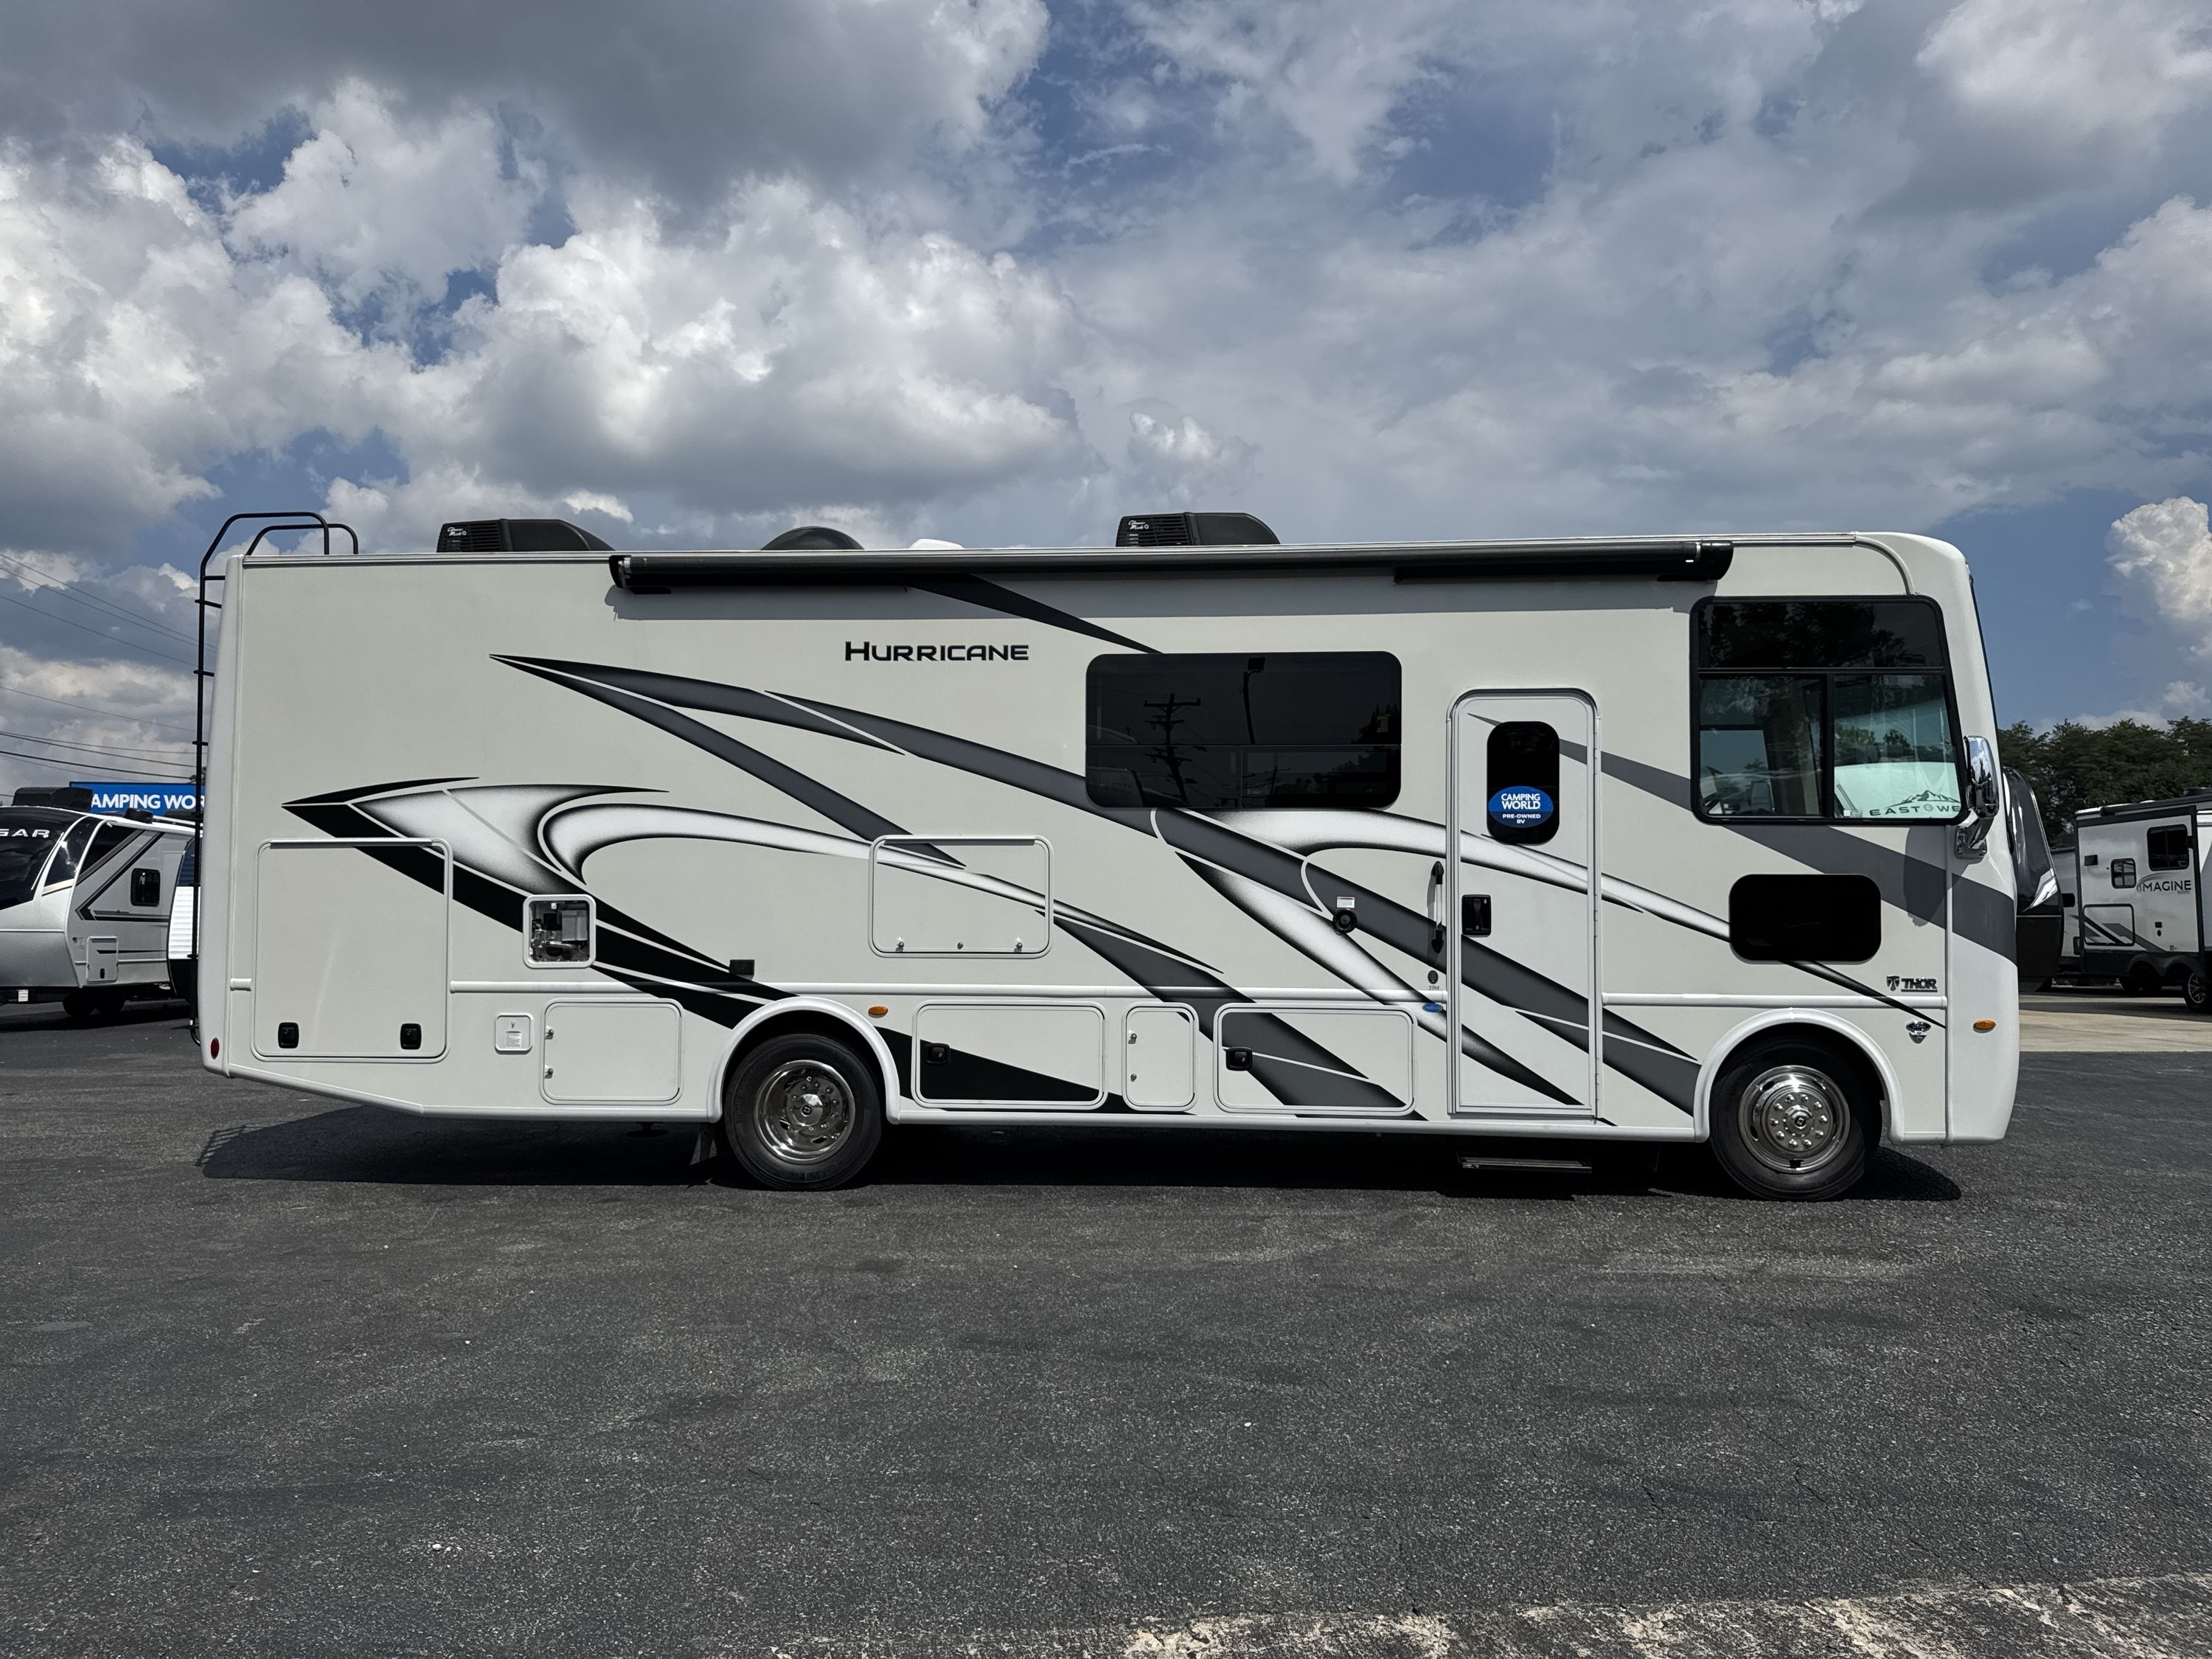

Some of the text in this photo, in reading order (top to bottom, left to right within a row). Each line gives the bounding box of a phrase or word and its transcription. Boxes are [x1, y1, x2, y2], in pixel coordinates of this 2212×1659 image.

[845, 641, 1029, 661] HURRICANE
[1500, 793, 1540, 801] CAMPING
[1501, 801, 1541, 810] WORLD
[1869, 806, 1920, 816] EAST
[2140, 880, 2191, 892] IMAGINE
[1901, 978, 1938, 989] THOR
